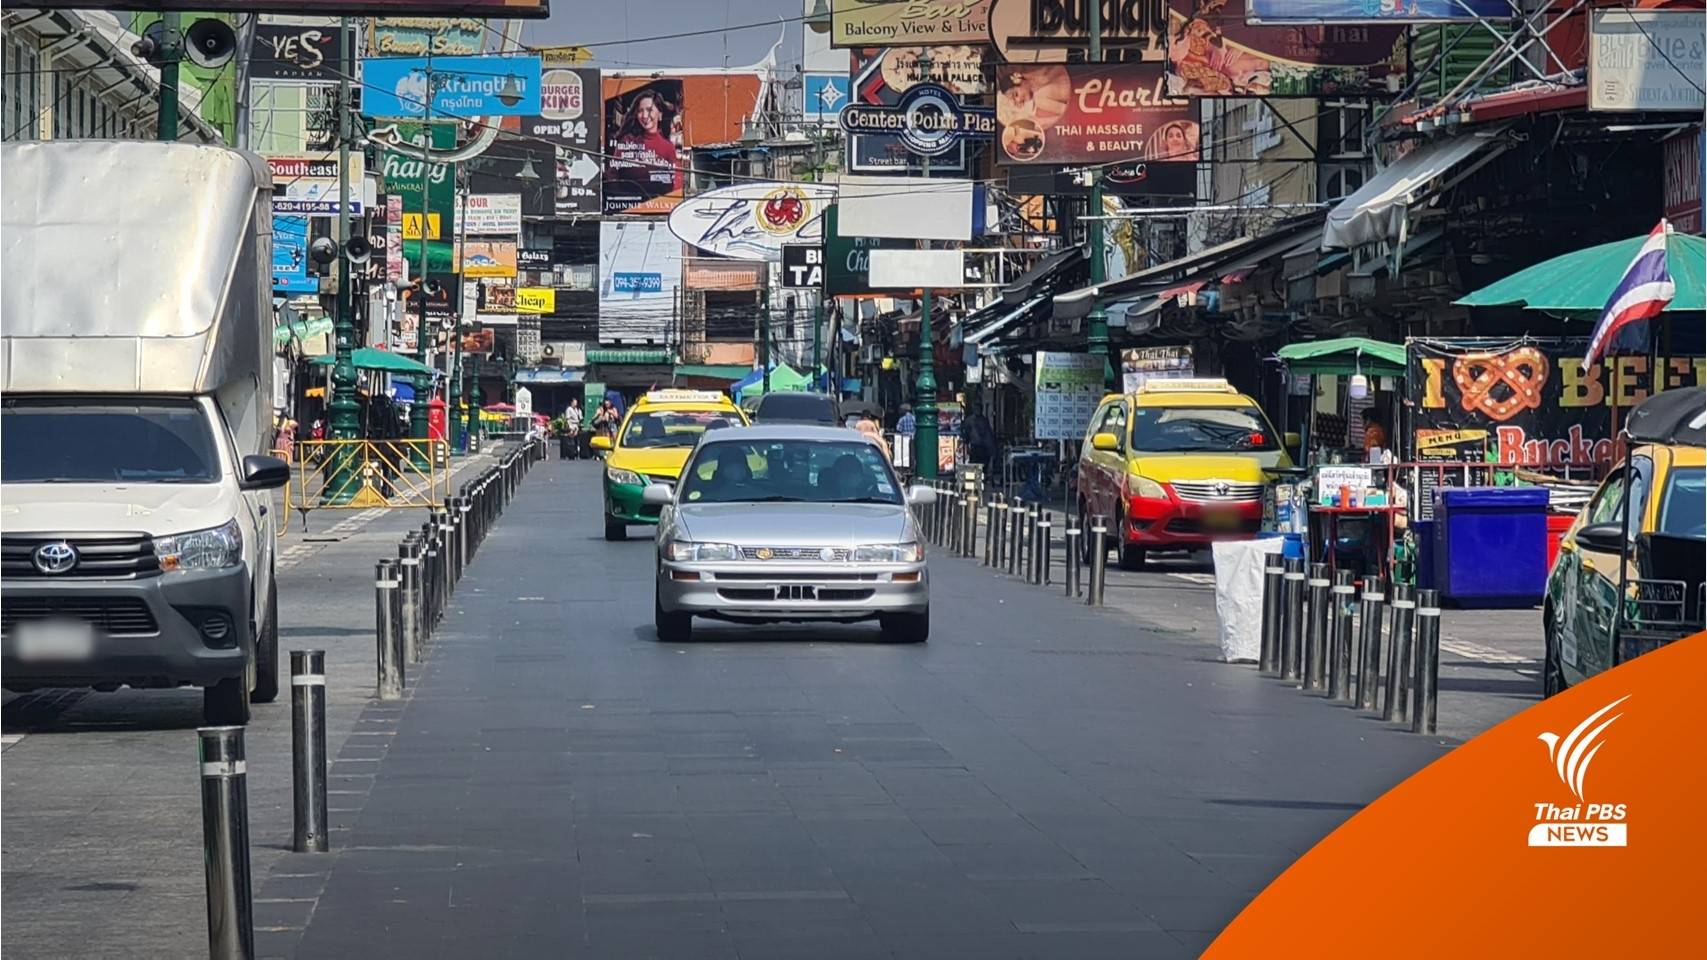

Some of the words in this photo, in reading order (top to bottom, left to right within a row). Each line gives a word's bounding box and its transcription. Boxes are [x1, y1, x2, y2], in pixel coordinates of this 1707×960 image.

[845, 22, 898, 38] Balcony
[902, 22, 936, 33] View
[942, 20, 952, 33] &
[958, 19, 987, 33] Live
[273, 30, 323, 68] YES
[541, 85, 580, 95] BURGER
[541, 96, 580, 109] KING
[847, 110, 905, 128] Center
[910, 111, 958, 129] Point
[533, 125, 560, 135] OPEN
[561, 120, 588, 138] 24
[1055, 125, 1082, 136] THAI
[1086, 124, 1143, 135] MASSAGE
[1086, 141, 1095, 151] &
[1099, 141, 1144, 151] BEAUTY
[268, 160, 338, 176] Southeast
[1421, 358, 1446, 408] I
[1428, 433, 1461, 445] MENU
